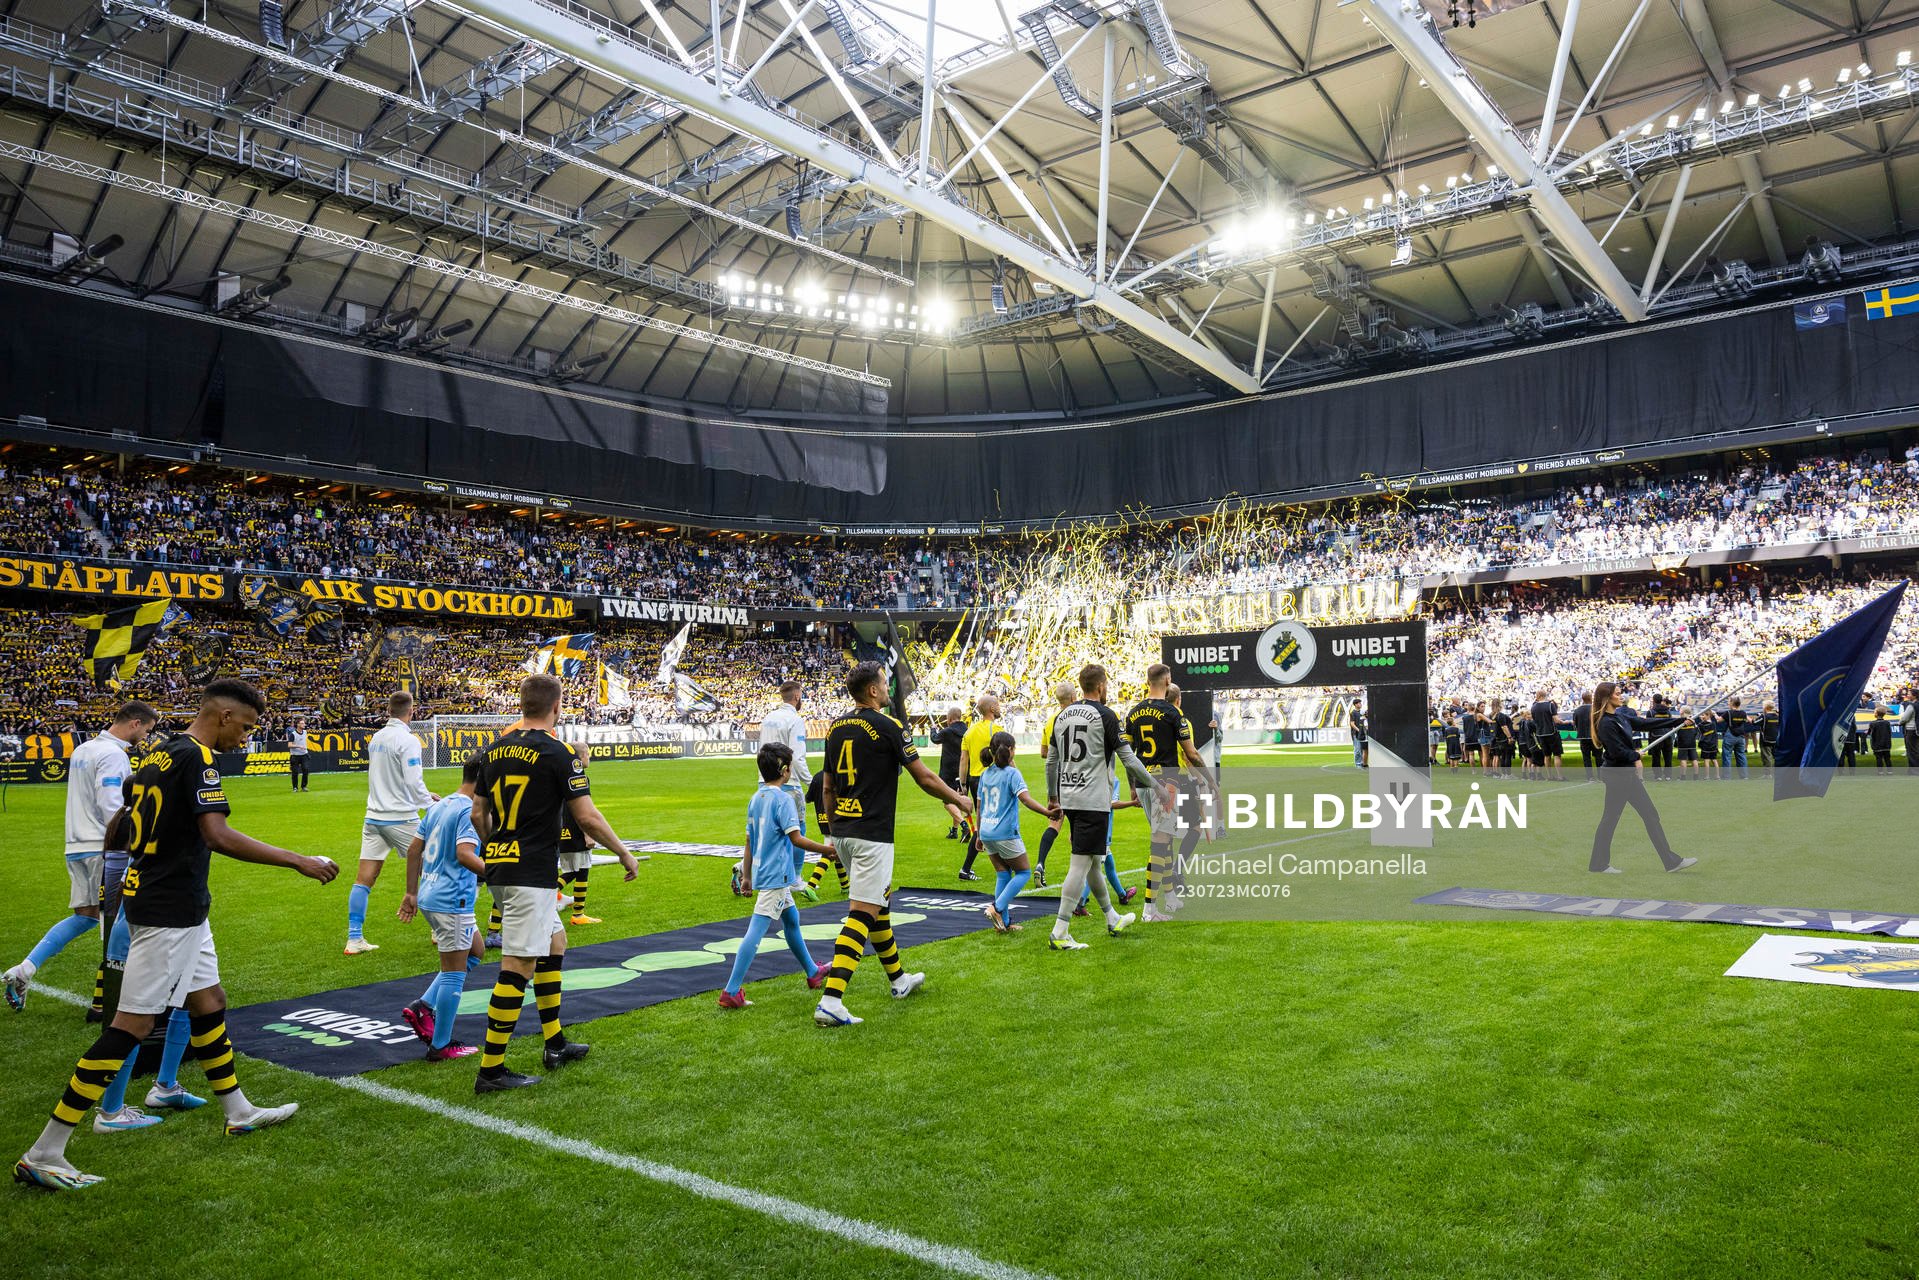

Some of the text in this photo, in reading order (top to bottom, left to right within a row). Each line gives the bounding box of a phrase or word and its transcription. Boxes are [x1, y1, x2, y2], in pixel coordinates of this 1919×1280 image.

[1419, 456, 1591, 486] TILLSAMMANS MOT MOBBNING FRIENDS ARENA
[455, 487, 544, 505] TILLSAMMANS MOT MOBBNING
[0, 557, 225, 600] STÅPLATS
[1582, 562, 1598, 573] AIK
[300, 578, 575, 618] AIK STOCKHOLM
[1222, 580, 1404, 626] AMBITION
[602, 599, 749, 626] IVAN TURINA
[1174, 645, 1242, 664] UNIBET
[1331, 635, 1409, 657] UNIBET
[1058, 703, 1097, 724] NORDFELDT
[1129, 707, 1164, 724] MILOŠEVIĆ
[1211, 696, 1354, 730] ASSION
[705, 741, 743, 753] KAPPEX
[1061, 724, 1088, 763] 15
[1139, 724, 1157, 758] 5
[1293, 730, 1347, 743] UNIBET
[450, 750, 473, 763] RO
[488, 745, 540, 766] THYCHOSEN
[614, 742, 683, 757] ICA Järvastaden
[836, 739, 857, 787] 4
[1061, 771, 1085, 784] SVEA
[200, 790, 226, 799] UNIBE
[490, 775, 530, 831] 17
[130, 784, 163, 854] 32
[486, 841, 520, 857] SVEA
[1552, 898, 1919, 938] ALLSV
[281, 1008, 419, 1044] UNIBET
